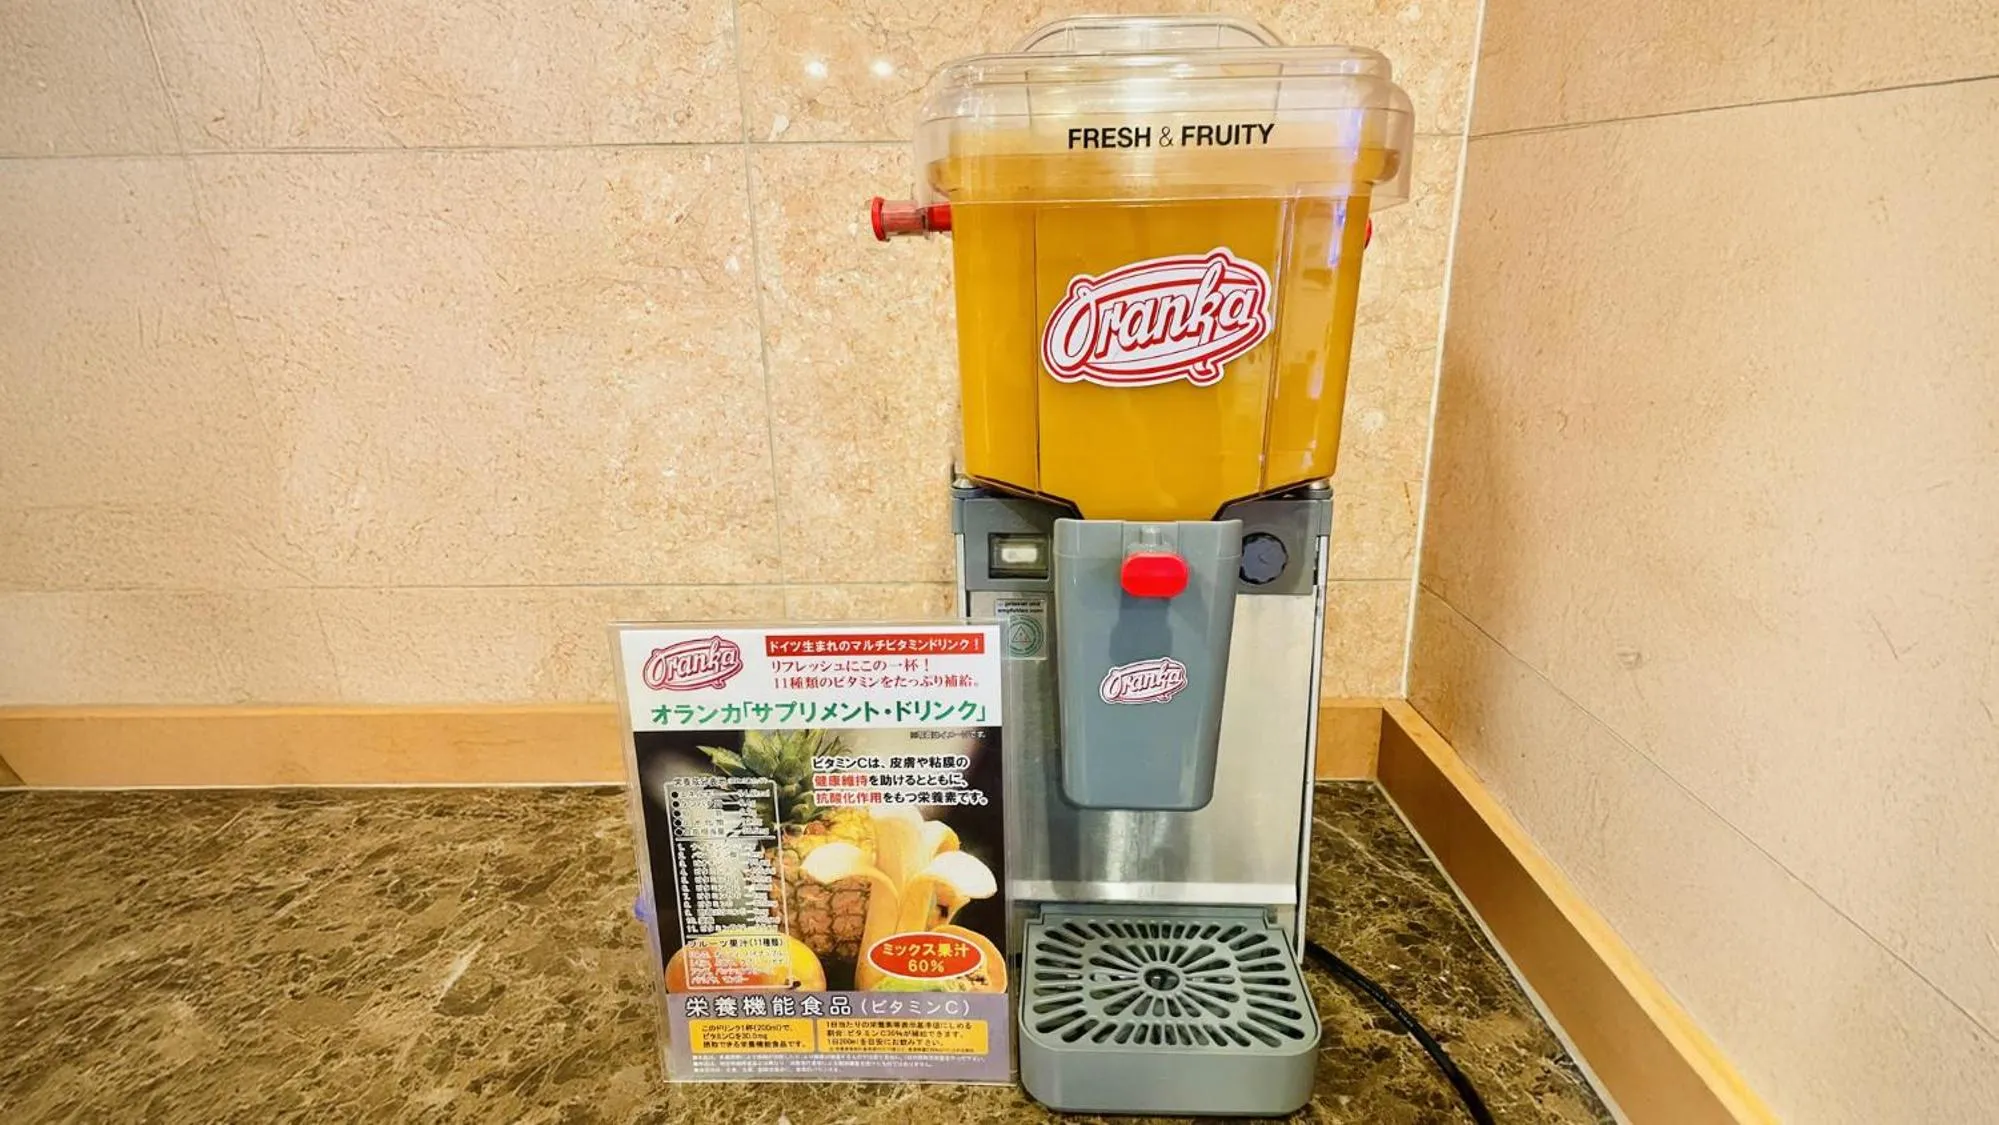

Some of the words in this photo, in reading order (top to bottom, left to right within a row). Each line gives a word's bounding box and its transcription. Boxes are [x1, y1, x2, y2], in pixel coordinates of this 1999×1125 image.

[1068, 126, 1152, 149] FRESH
[1158, 126, 1174, 146] &
[1181, 123, 1275, 147] FRUITY
[1046, 256, 1264, 378] Oranka
[768, 636, 982, 654] ドイツ生まれのマルチビタミンドリンク！
[643, 637, 744, 690] Oranka
[771, 657, 931, 673] リフレッシュにこの一杯！
[773, 673, 980, 690] 11種類のビタミンをたっぷり補給。
[1102, 660, 1185, 700] Oranka
[651, 701, 988, 727] オランカ「サプリメント・ドリンク」
[812, 756, 969, 769] ビタミンCは、皮膚や粘膜の
[814, 774, 968, 787] 健康維持を助けるとともに、
[816, 791, 988, 805] 抗酸化作用をもつ栄養素です。
[882, 943, 970, 958] ミックス果汁
[908, 959, 945, 973] 60%
